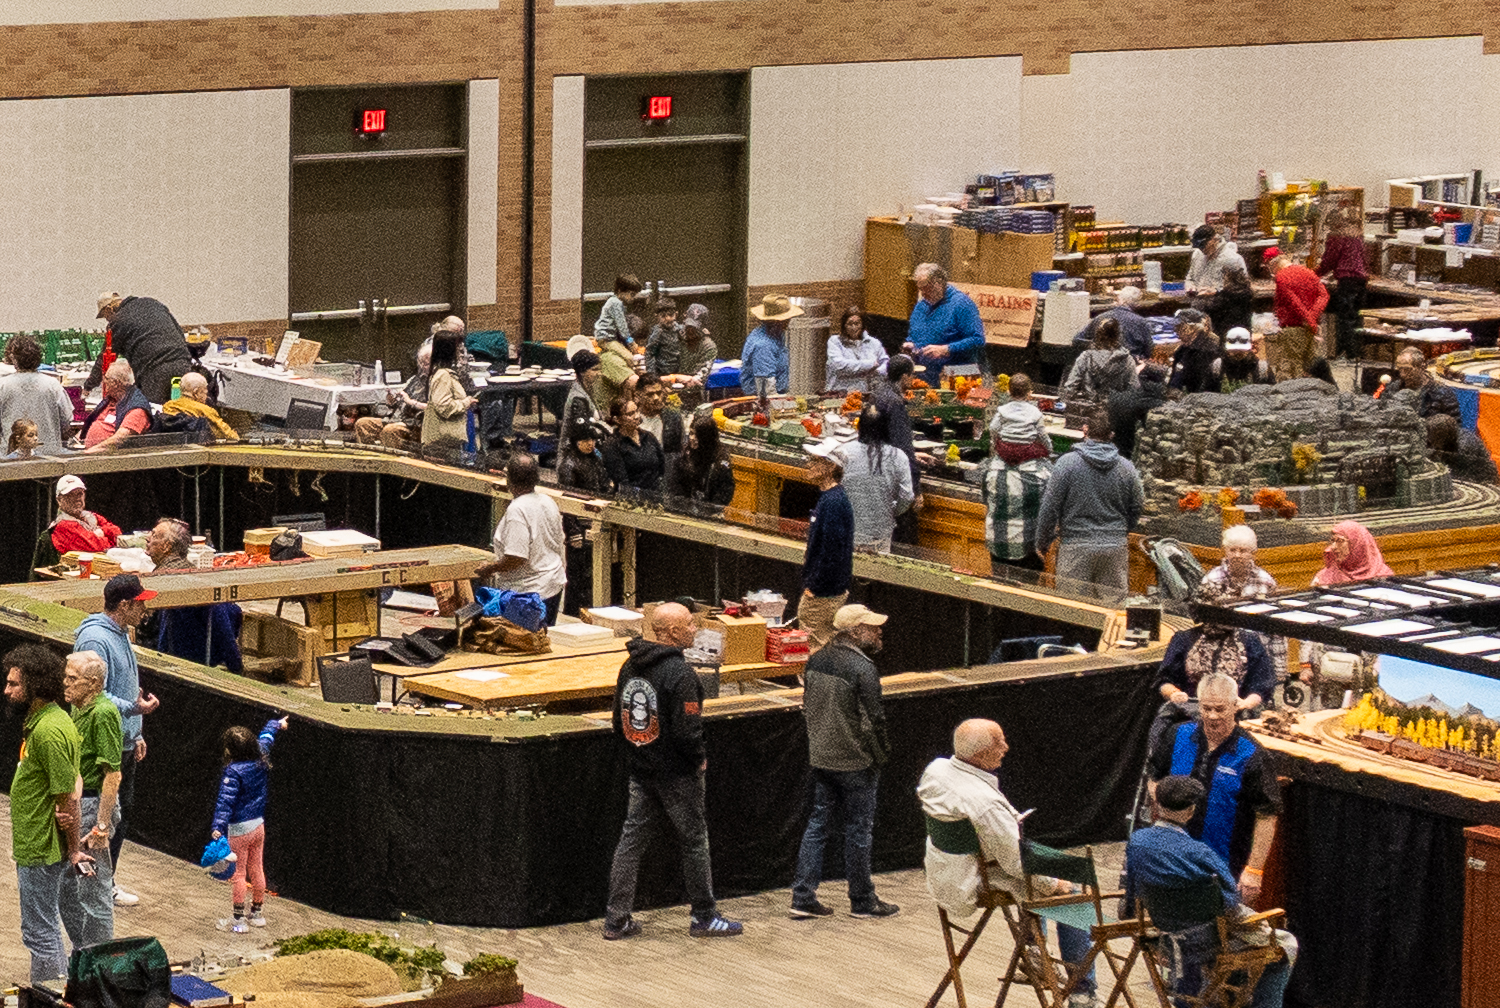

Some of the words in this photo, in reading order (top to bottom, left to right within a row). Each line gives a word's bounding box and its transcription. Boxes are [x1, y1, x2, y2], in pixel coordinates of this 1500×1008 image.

[651, 97, 671, 117] EXIT
[364, 110, 385, 131] EXIT
[978, 292, 1032, 311] TRAINS
